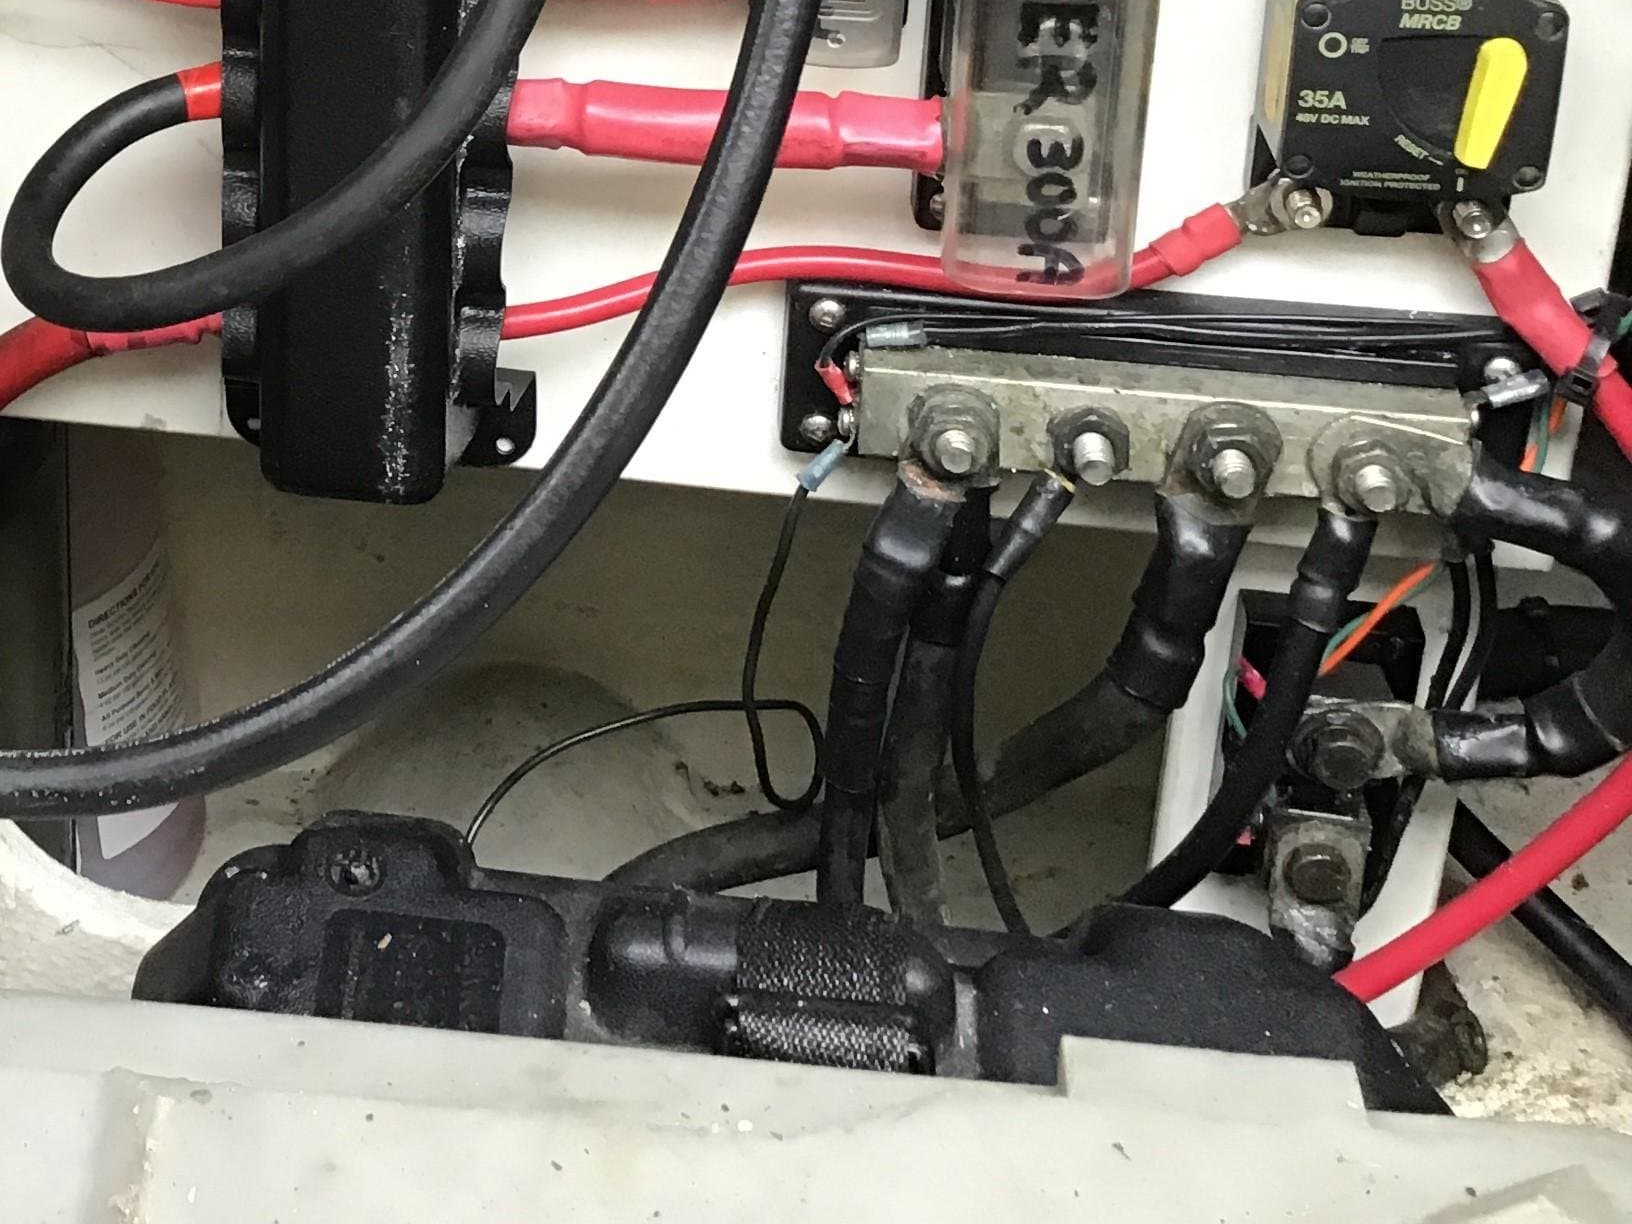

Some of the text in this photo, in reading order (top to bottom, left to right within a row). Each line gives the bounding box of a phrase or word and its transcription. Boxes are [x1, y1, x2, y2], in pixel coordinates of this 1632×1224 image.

[1399, 13, 1462, 30] MRCB
[1298, 90, 1347, 109] 35A
[1320, 114, 1340, 125] DC
[1341, 115, 1370, 126] MAX
[1016, 137, 1085, 286] 300A
